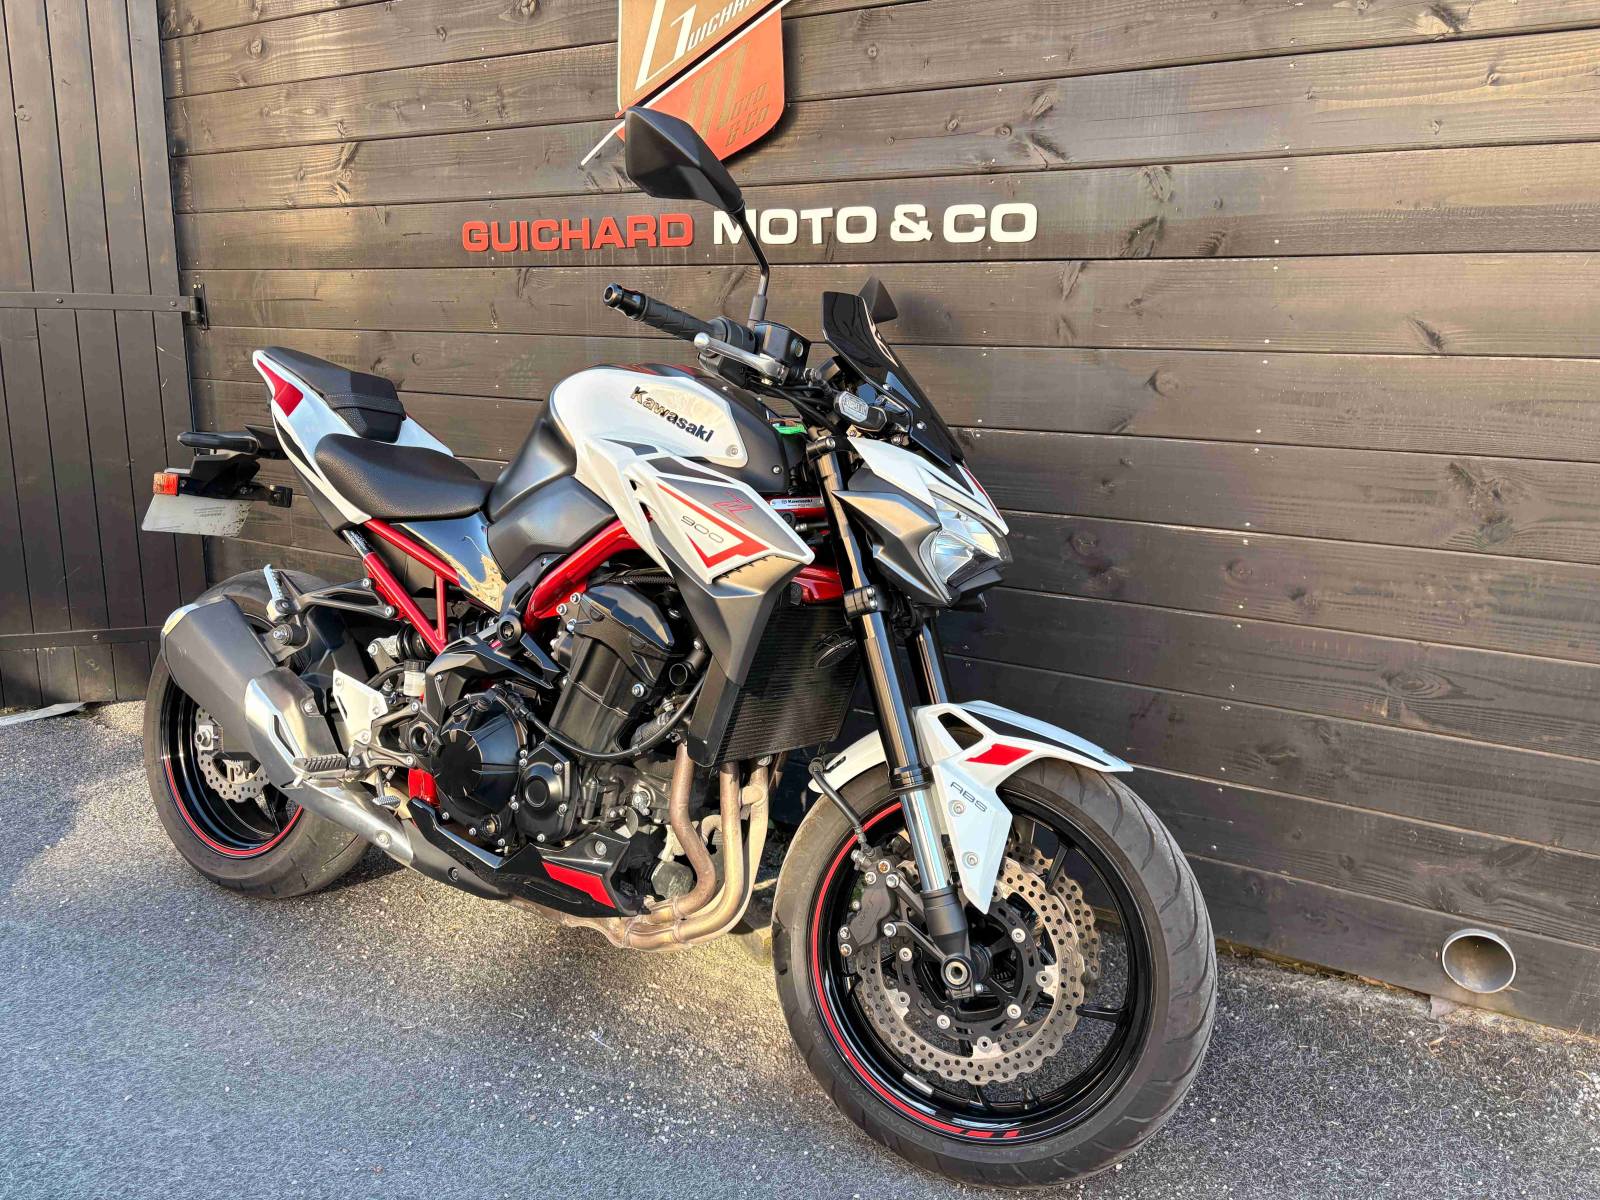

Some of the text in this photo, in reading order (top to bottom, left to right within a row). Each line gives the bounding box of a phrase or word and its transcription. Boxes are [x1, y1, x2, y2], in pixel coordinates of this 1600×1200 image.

[462, 202, 1038, 252] GUICHARD MOTO & CO
[630, 386, 715, 443] Kawasaki
[680, 515, 725, 545] 900
[950, 781, 988, 813] ABS
